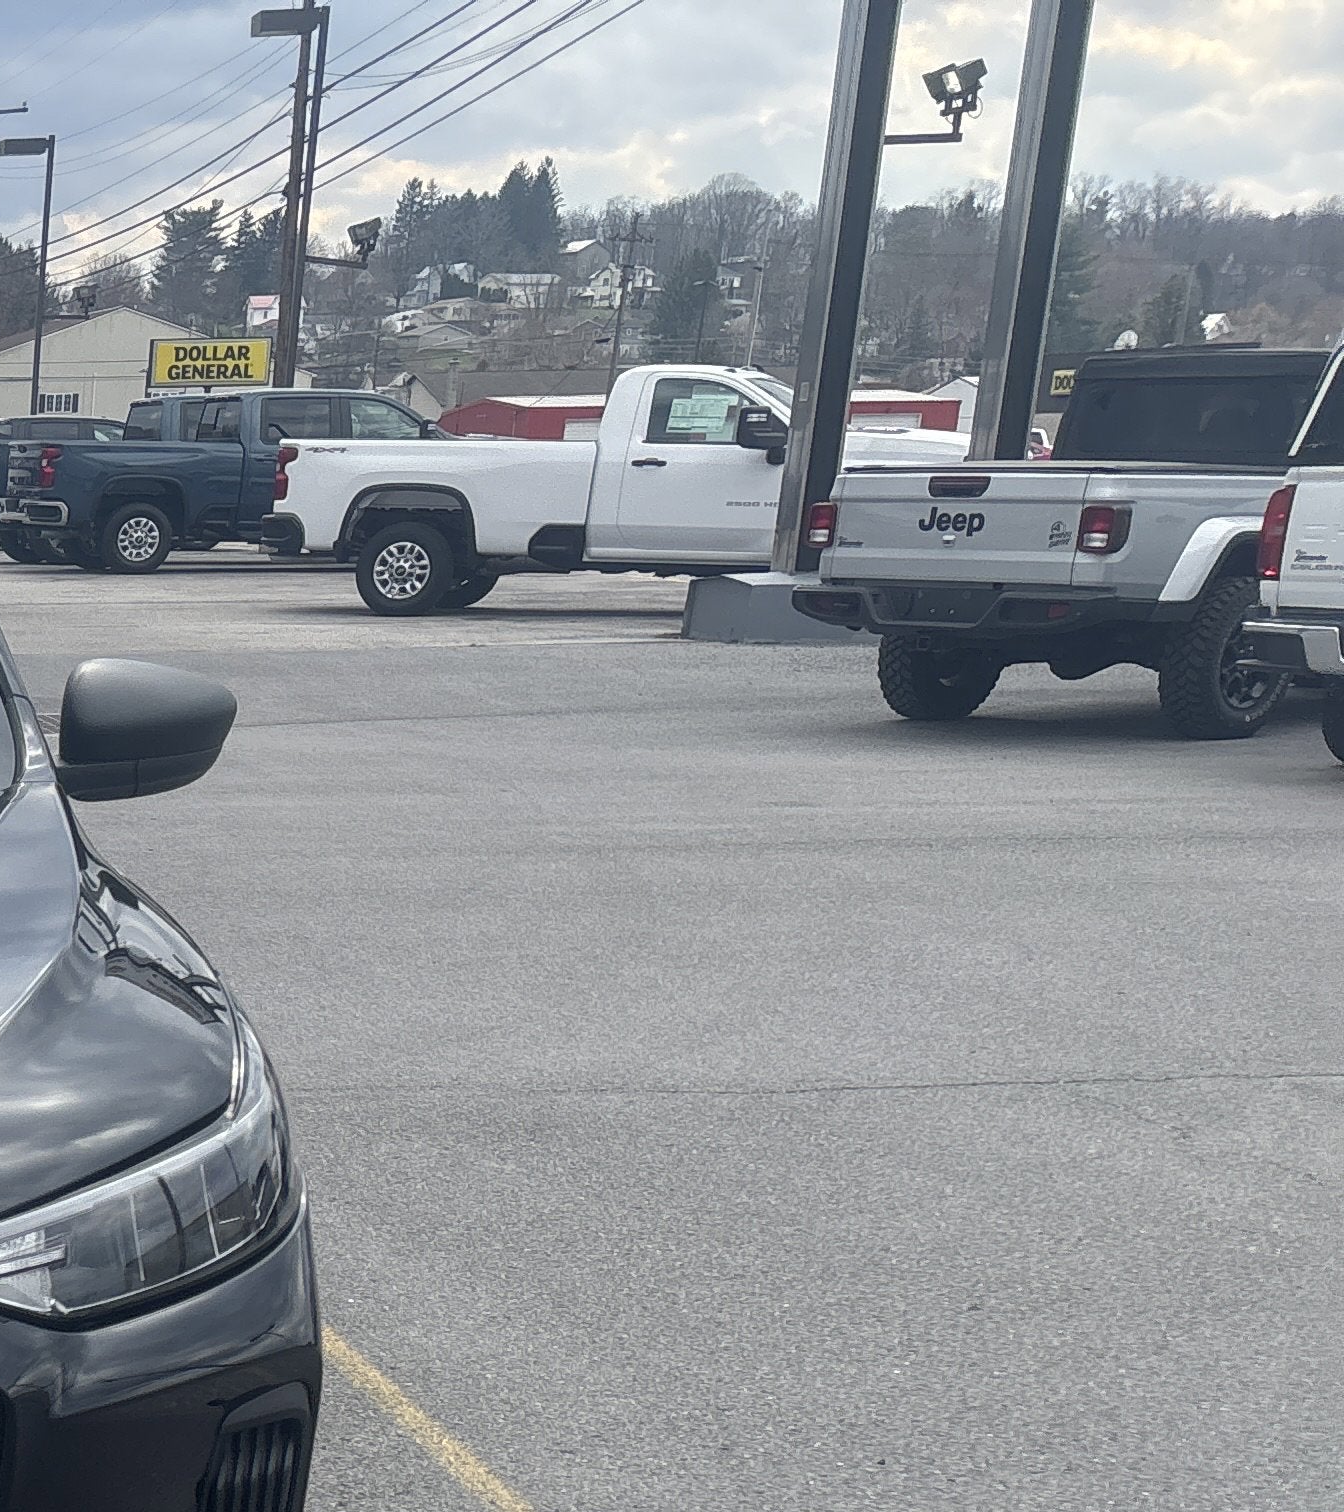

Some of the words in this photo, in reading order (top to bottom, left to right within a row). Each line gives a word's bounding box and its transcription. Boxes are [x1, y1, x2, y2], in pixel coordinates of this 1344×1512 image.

[173, 345, 251, 362] DOLLAR
[167, 363, 254, 380] GENERAL
[918, 506, 985, 537] Jeep
